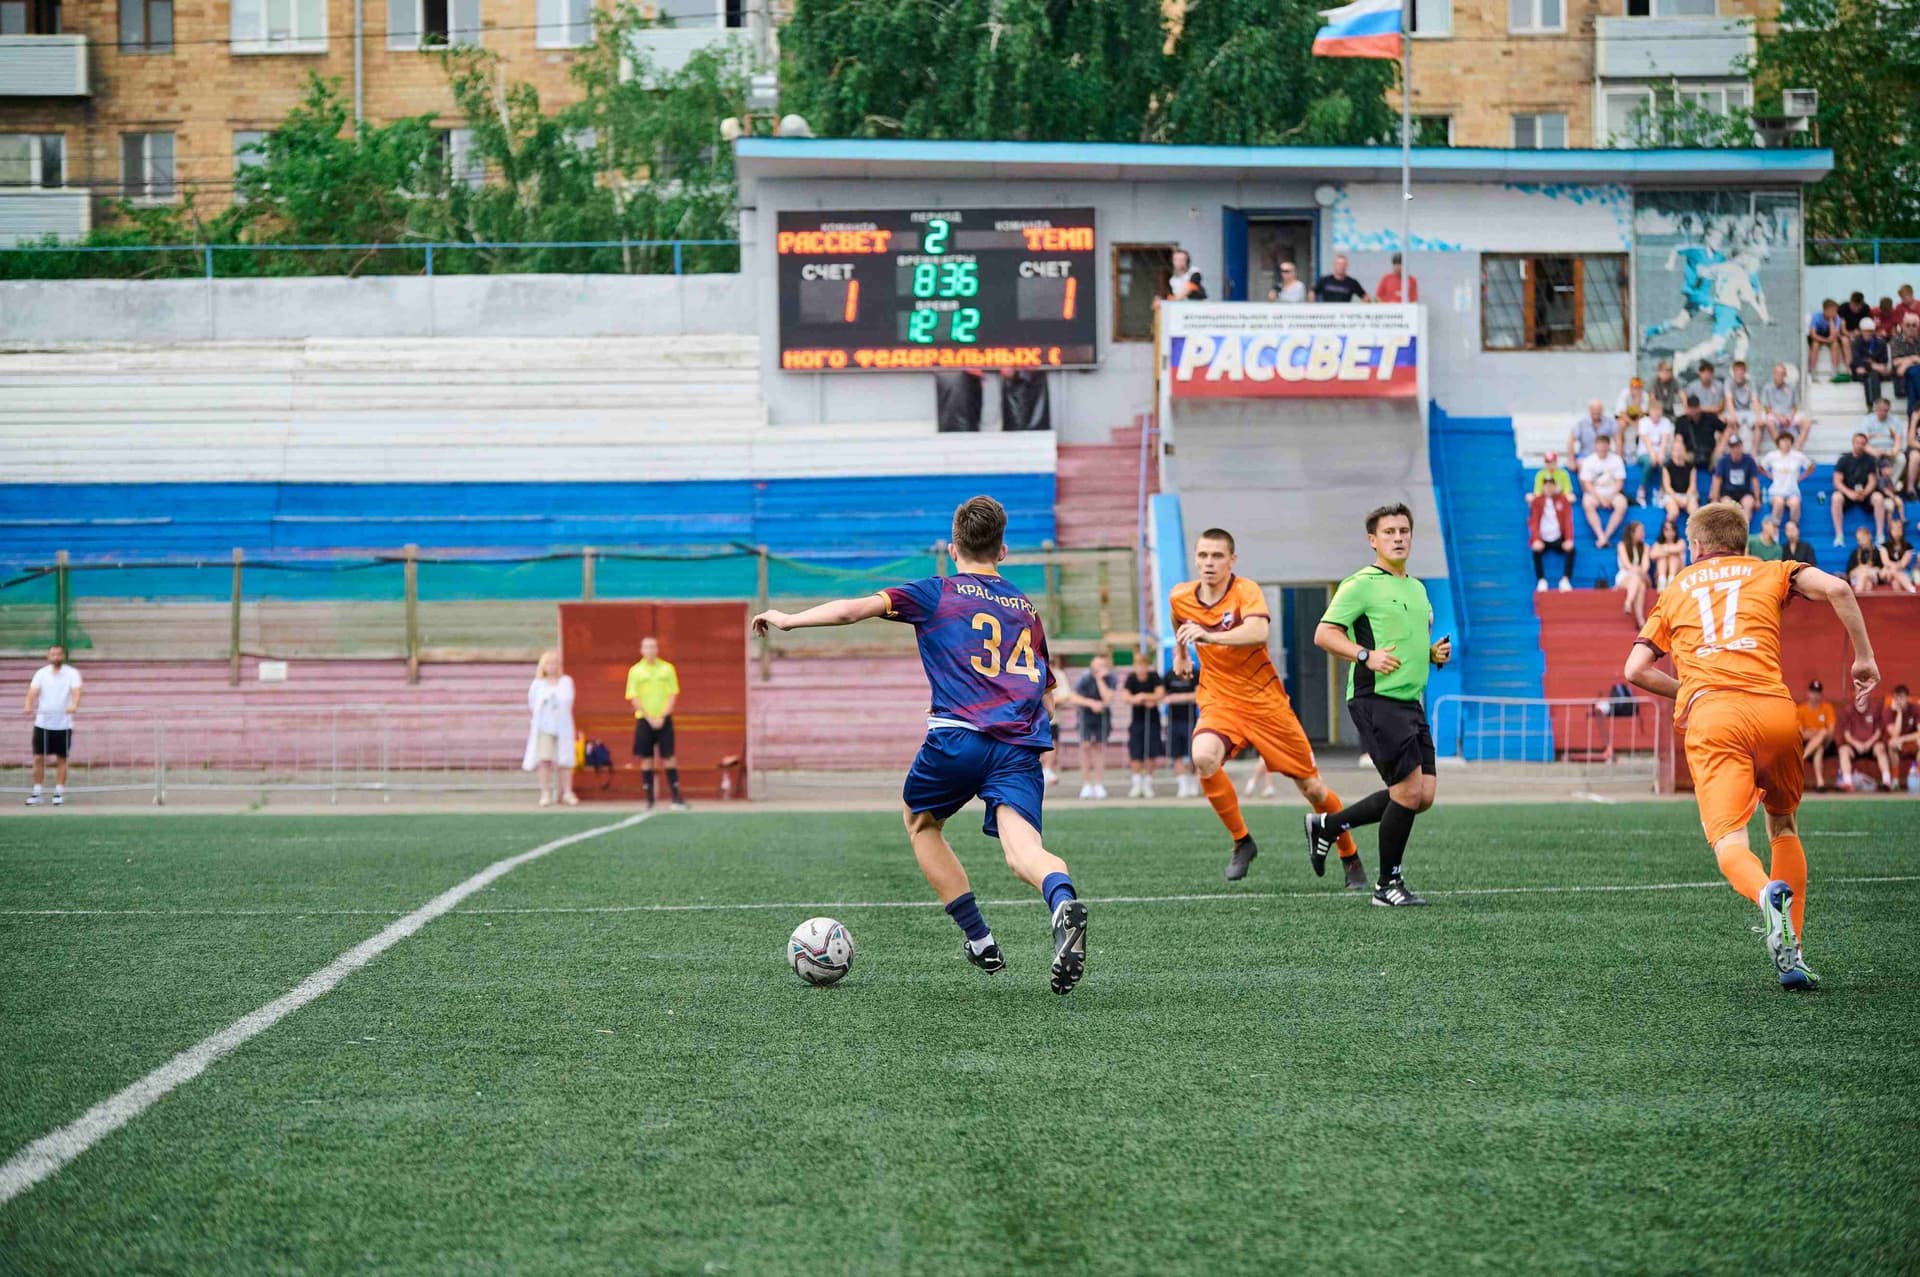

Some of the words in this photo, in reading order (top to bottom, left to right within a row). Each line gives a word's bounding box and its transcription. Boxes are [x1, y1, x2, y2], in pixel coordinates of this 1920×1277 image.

[778, 230, 892, 254] РАССВЕТ
[924, 219, 950, 254] 2
[1023, 227, 1094, 251] ТЕМП
[802, 264, 855, 280] СЧЕТ
[1019, 261, 1072, 278] СЧЕТ
[845, 279, 859, 322] 1
[1063, 277, 1077, 319] 1
[1176, 335, 1410, 381] РАССВЕТ
[1680, 565, 1752, 592] КУЗЬКИН
[1691, 580, 1742, 645] 17
[970, 612, 1041, 684] 34
